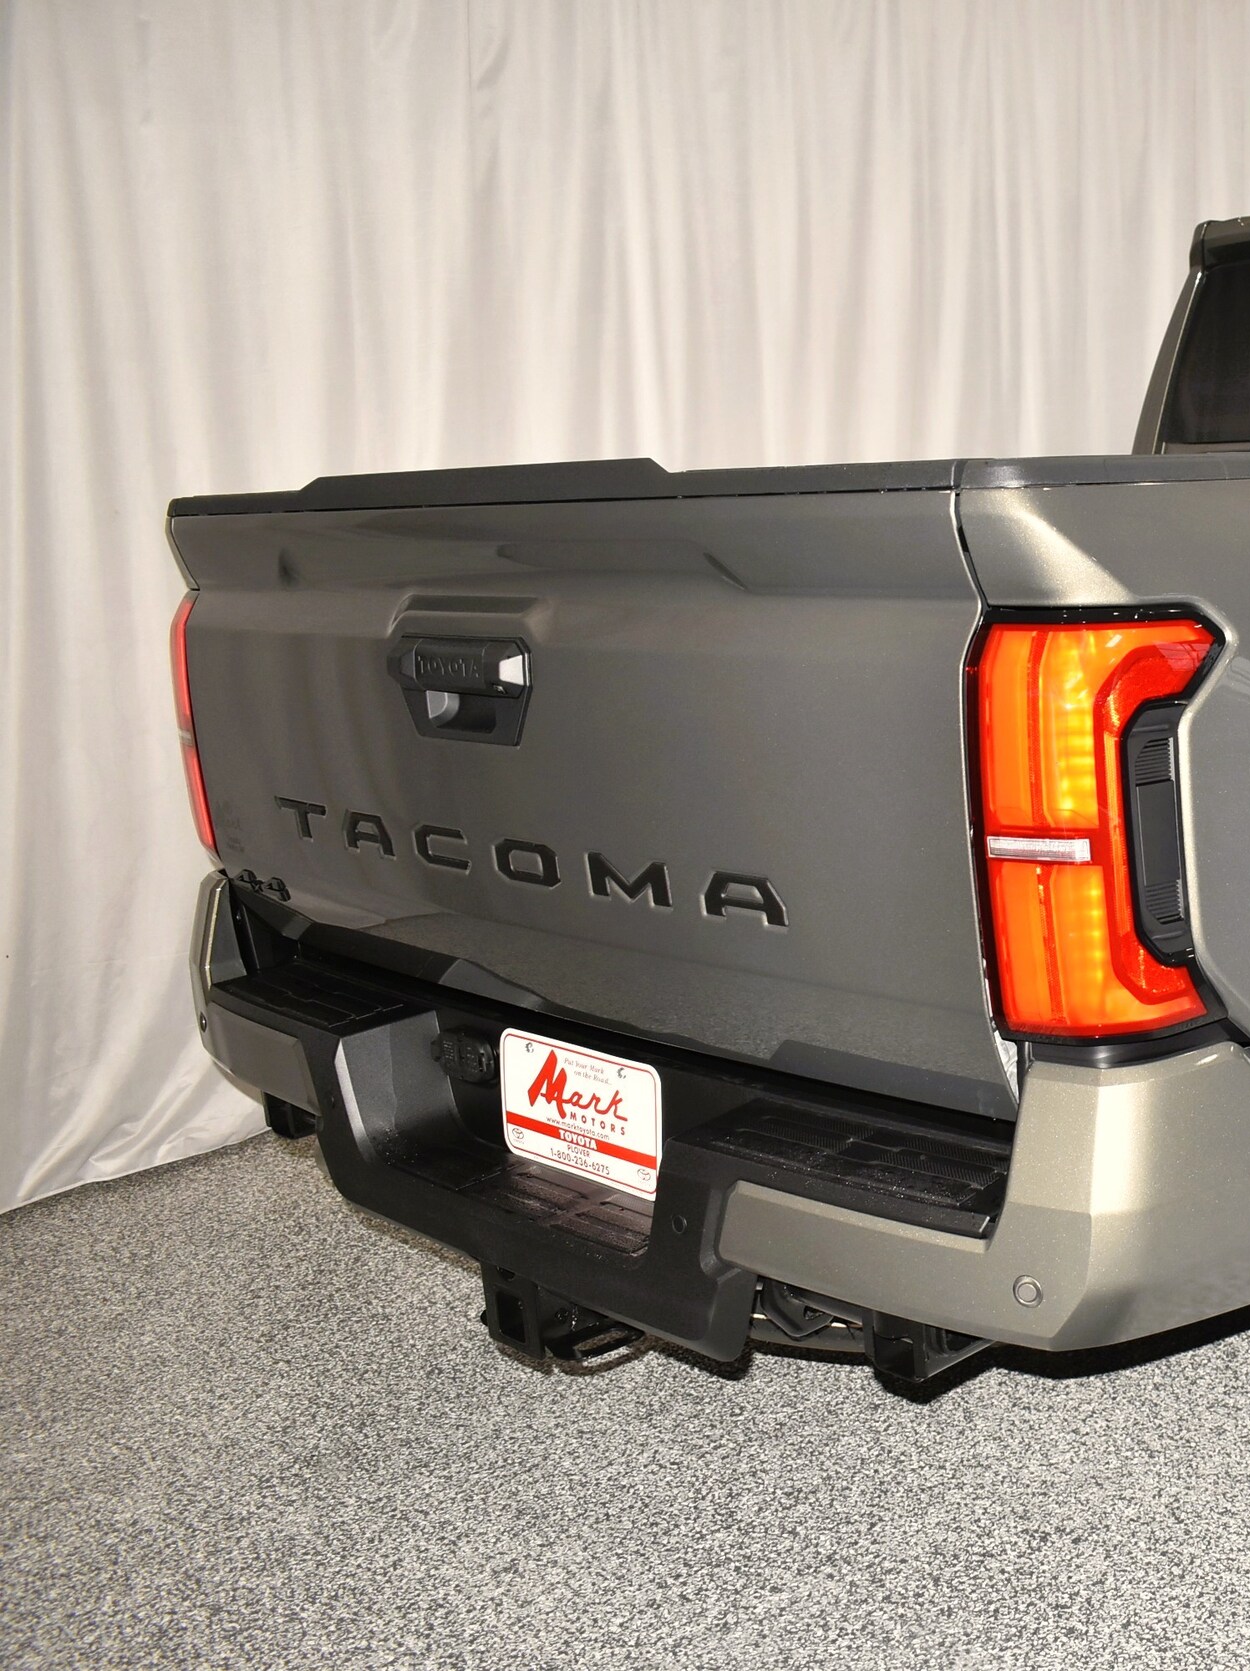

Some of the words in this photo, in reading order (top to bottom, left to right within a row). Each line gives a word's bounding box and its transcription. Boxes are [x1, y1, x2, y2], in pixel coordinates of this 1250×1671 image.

[417, 655, 481, 679] TOYOTA
[273, 795, 791, 934] TACOMA
[564, 1057, 574, 1065] Put
[575, 1060, 588, 1070] Your
[589, 1064, 605, 1075] Mark
[582, 1071, 592, 1081] the
[527, 1049, 629, 1122] Mark
[545, 1116, 610, 1141] www.marktoyota.com
[569, 1111, 626, 1136] MOTORS
[558, 1129, 598, 1151] TOYOTA
[566, 1144, 591, 1158] PLOVER
[549, 1147, 611, 1175] 1-800-236-6275
